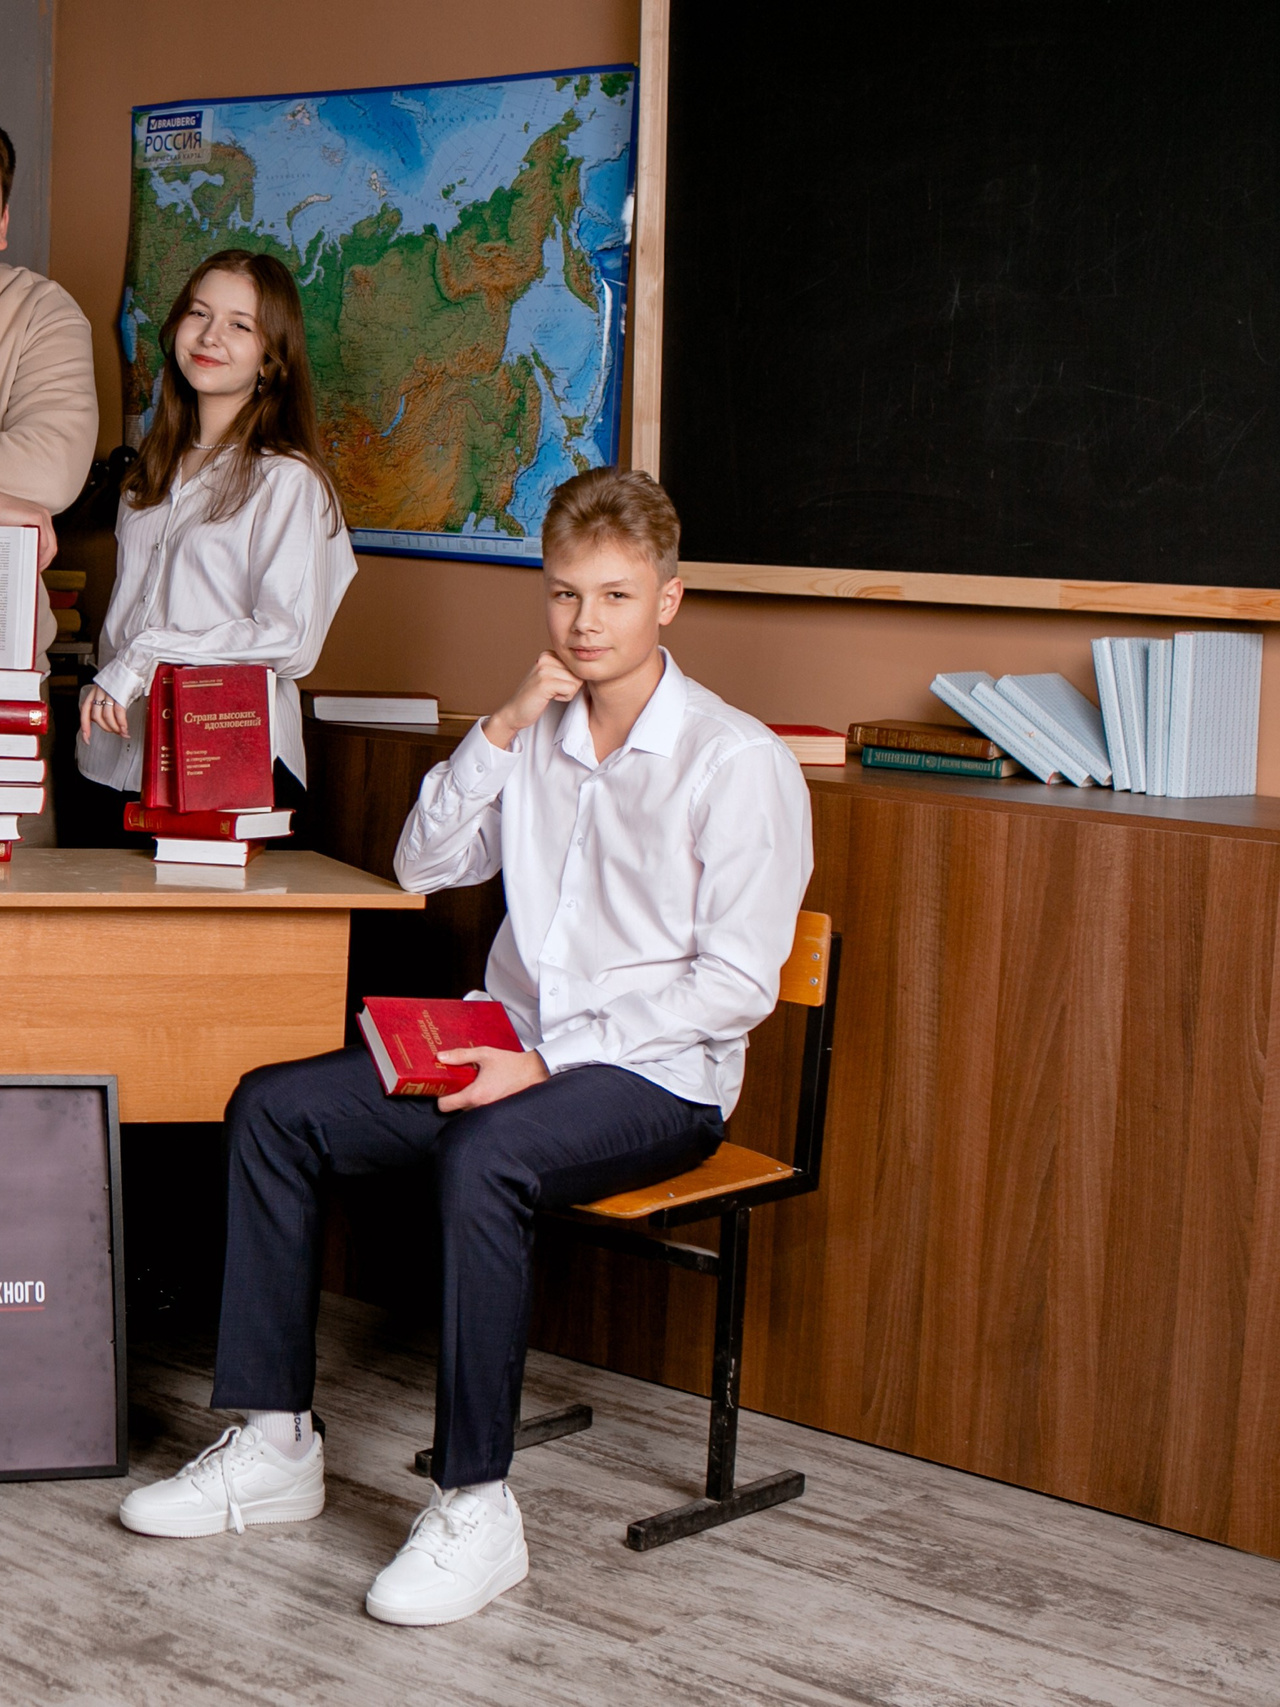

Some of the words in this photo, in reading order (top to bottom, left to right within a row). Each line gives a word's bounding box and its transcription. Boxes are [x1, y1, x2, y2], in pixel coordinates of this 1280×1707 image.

[157, 116, 196, 129] BRAUBERG
[144, 131, 202, 154] РОССИЯ
[184, 711, 217, 725] Страна
[218, 711, 256, 720] высоких
[204, 717, 262, 731] вдохновений
